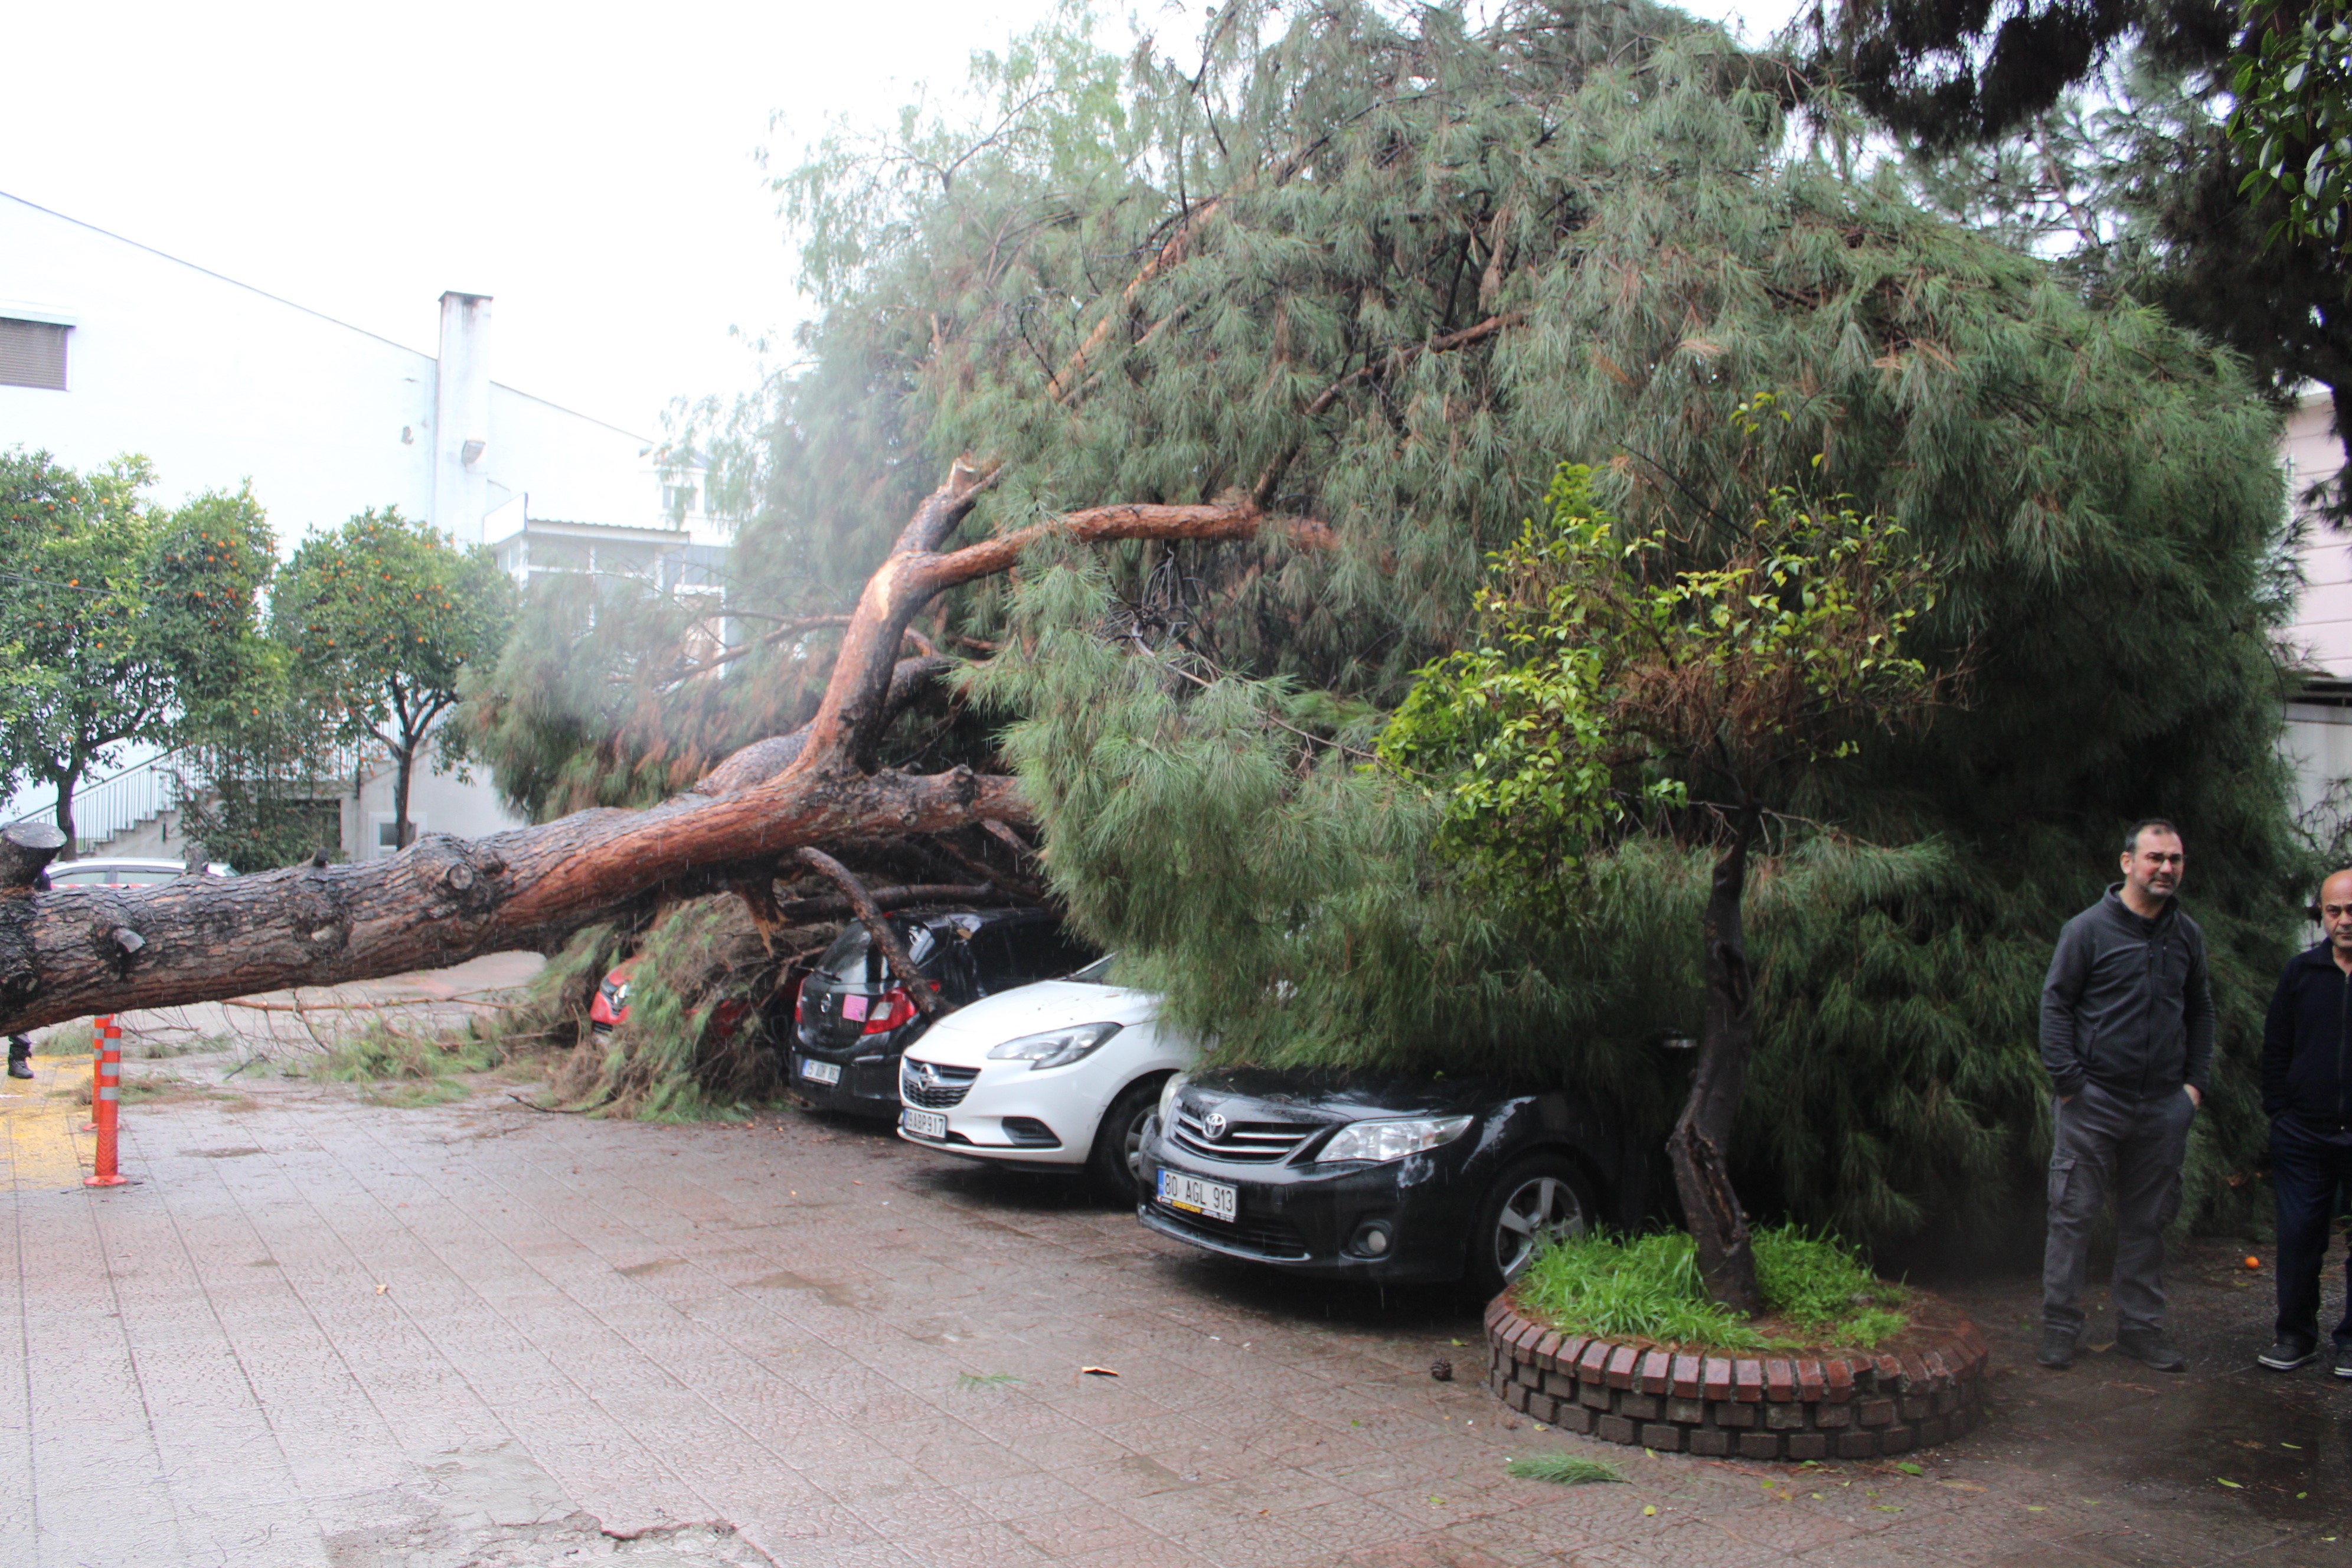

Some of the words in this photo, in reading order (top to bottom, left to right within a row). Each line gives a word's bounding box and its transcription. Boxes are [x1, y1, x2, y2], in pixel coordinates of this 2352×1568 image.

[1165, 1174, 1178, 1197] 80
[1185, 1180, 1206, 1205] AGL
[1213, 1187, 1233, 1211] 913
